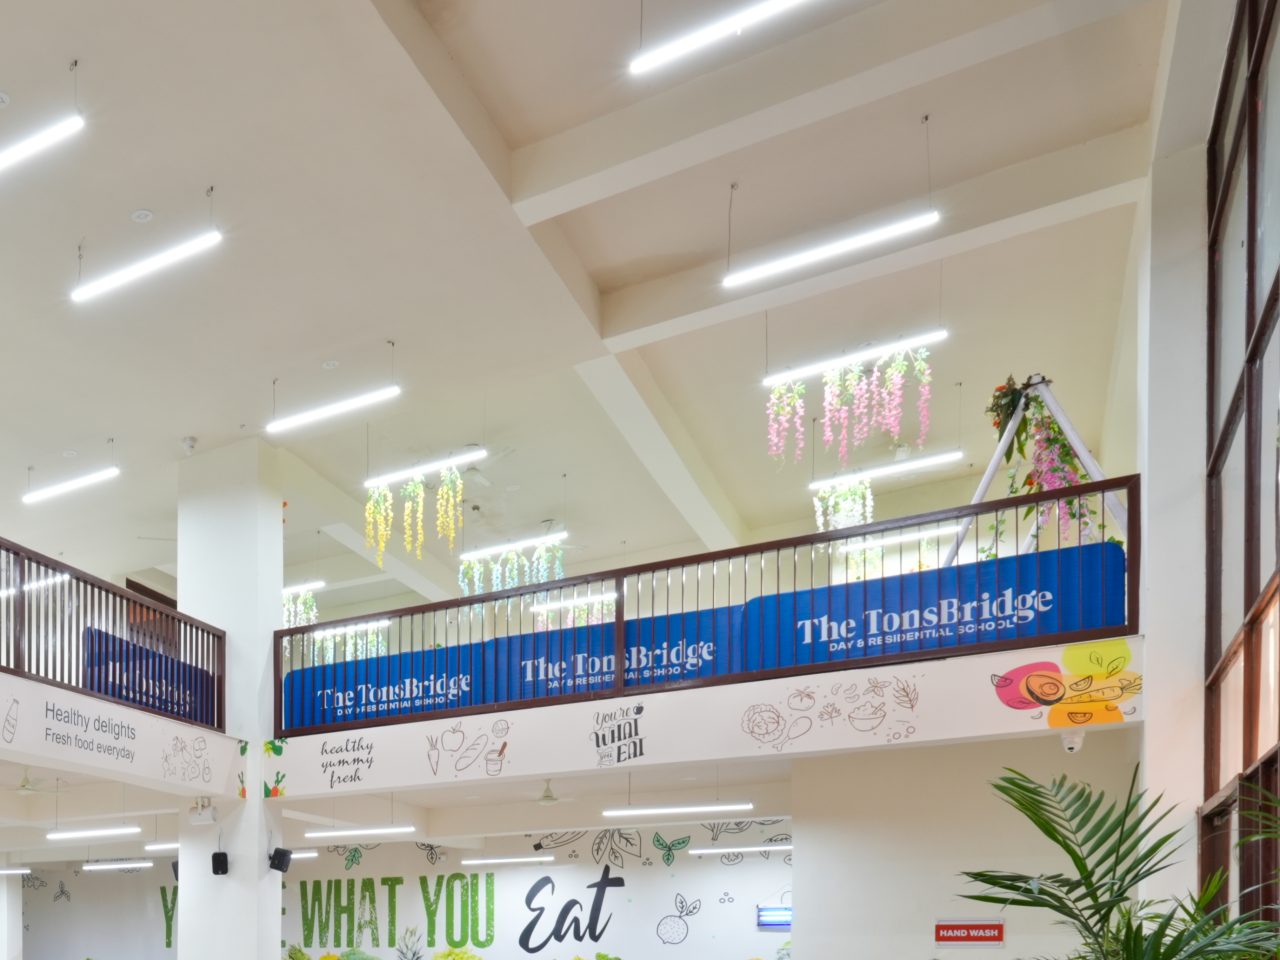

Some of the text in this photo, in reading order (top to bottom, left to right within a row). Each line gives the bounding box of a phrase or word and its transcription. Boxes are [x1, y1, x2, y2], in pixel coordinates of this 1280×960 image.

[797, 587, 1053, 645] The TonsBridge
[829, 641, 854, 651] DAY
[868, 628, 954, 647] RESIDENTIAL
[958, 619, 1015, 634] SCHOOL
[521, 656, 567, 682] The
[317, 673, 471, 710] The TonsBridge
[45, 701, 136, 740] Healthy delights
[589, 718, 640, 748] WHAT
[45, 728, 135, 763] Fresh food everyday
[321, 737, 374, 755] healthy
[617, 737, 646, 763] EAT
[321, 757, 373, 773] yummy
[330, 768, 362, 789] fresh
[299, 877, 404, 949] WHAT
[419, 872, 495, 949] YOU
[519, 864, 626, 954] Eat
[939, 929, 998, 937] HAND WASH
